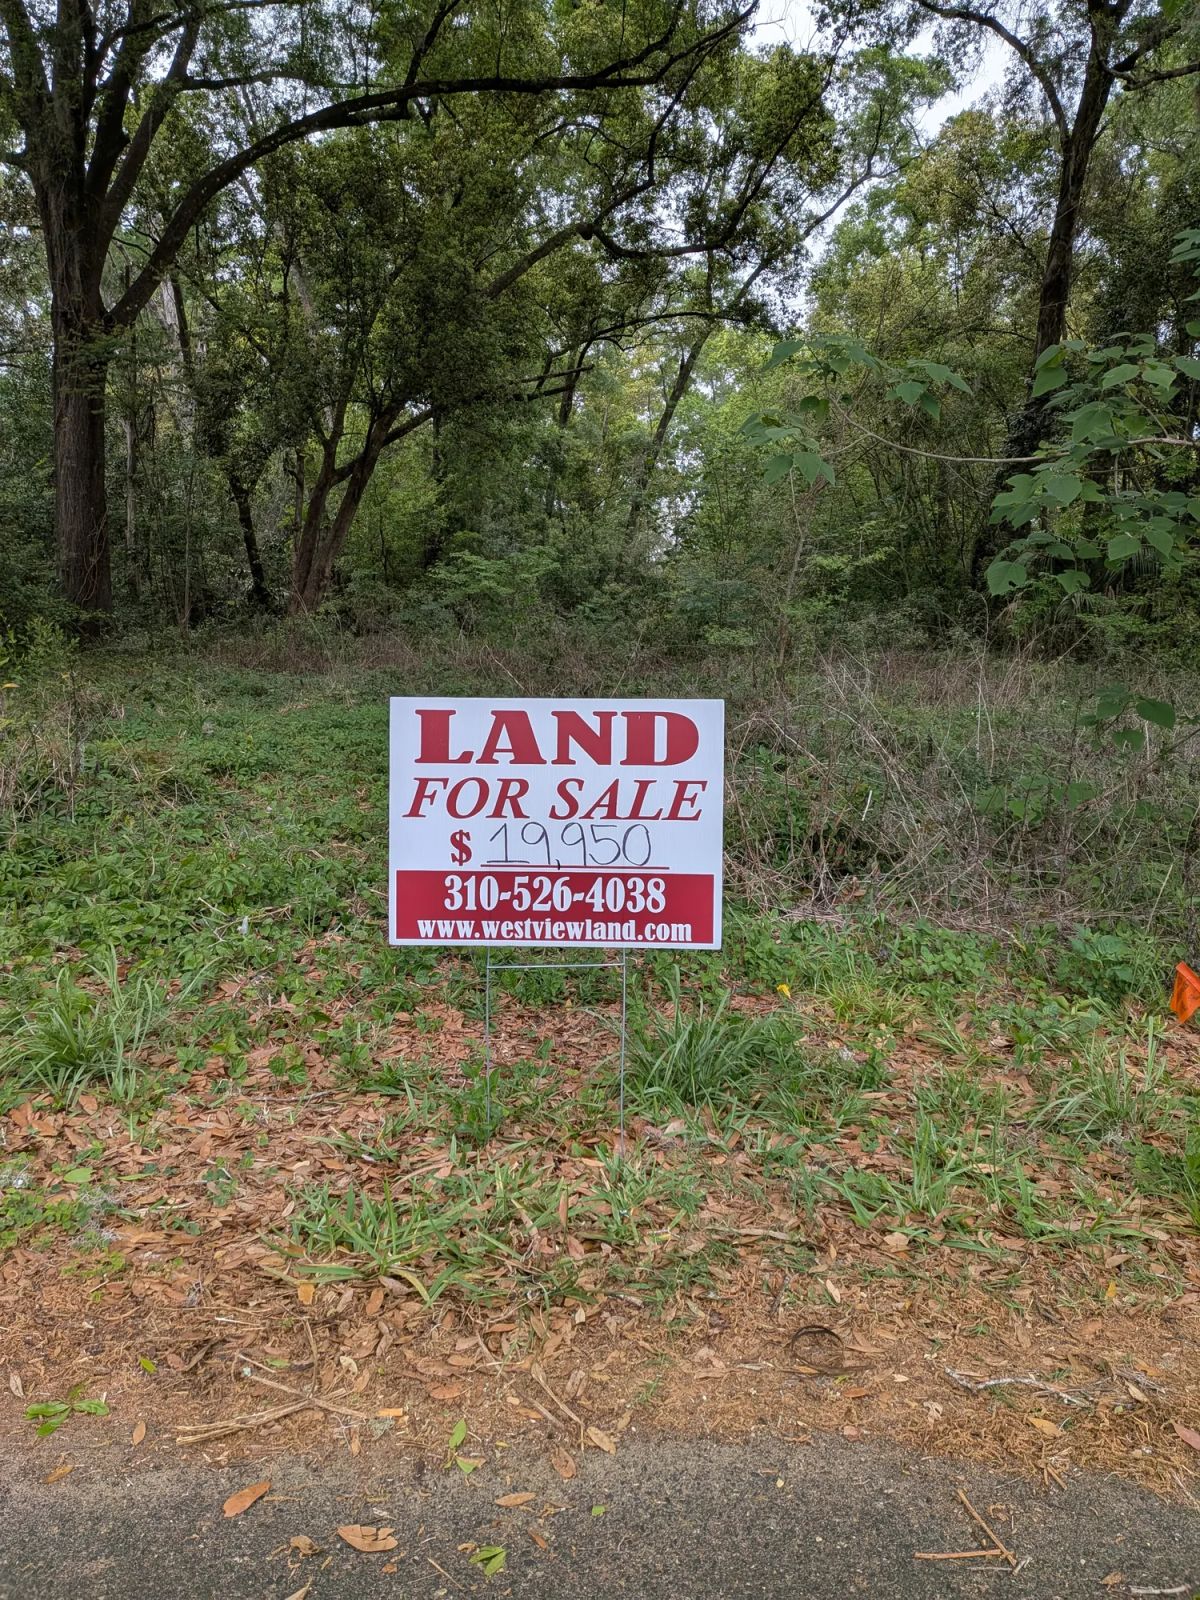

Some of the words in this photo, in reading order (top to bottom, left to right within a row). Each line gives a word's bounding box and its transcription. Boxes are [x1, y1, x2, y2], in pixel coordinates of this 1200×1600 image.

[415, 709, 699, 766] LAND
[402, 776, 530, 820] FOR
[549, 778, 708, 821] SALE
[450, 829, 472, 866] $
[486, 821, 651, 870] 19,950
[444, 874, 666, 913] 310-526-4038
[417, 917, 692, 943] www.westviewland.com
